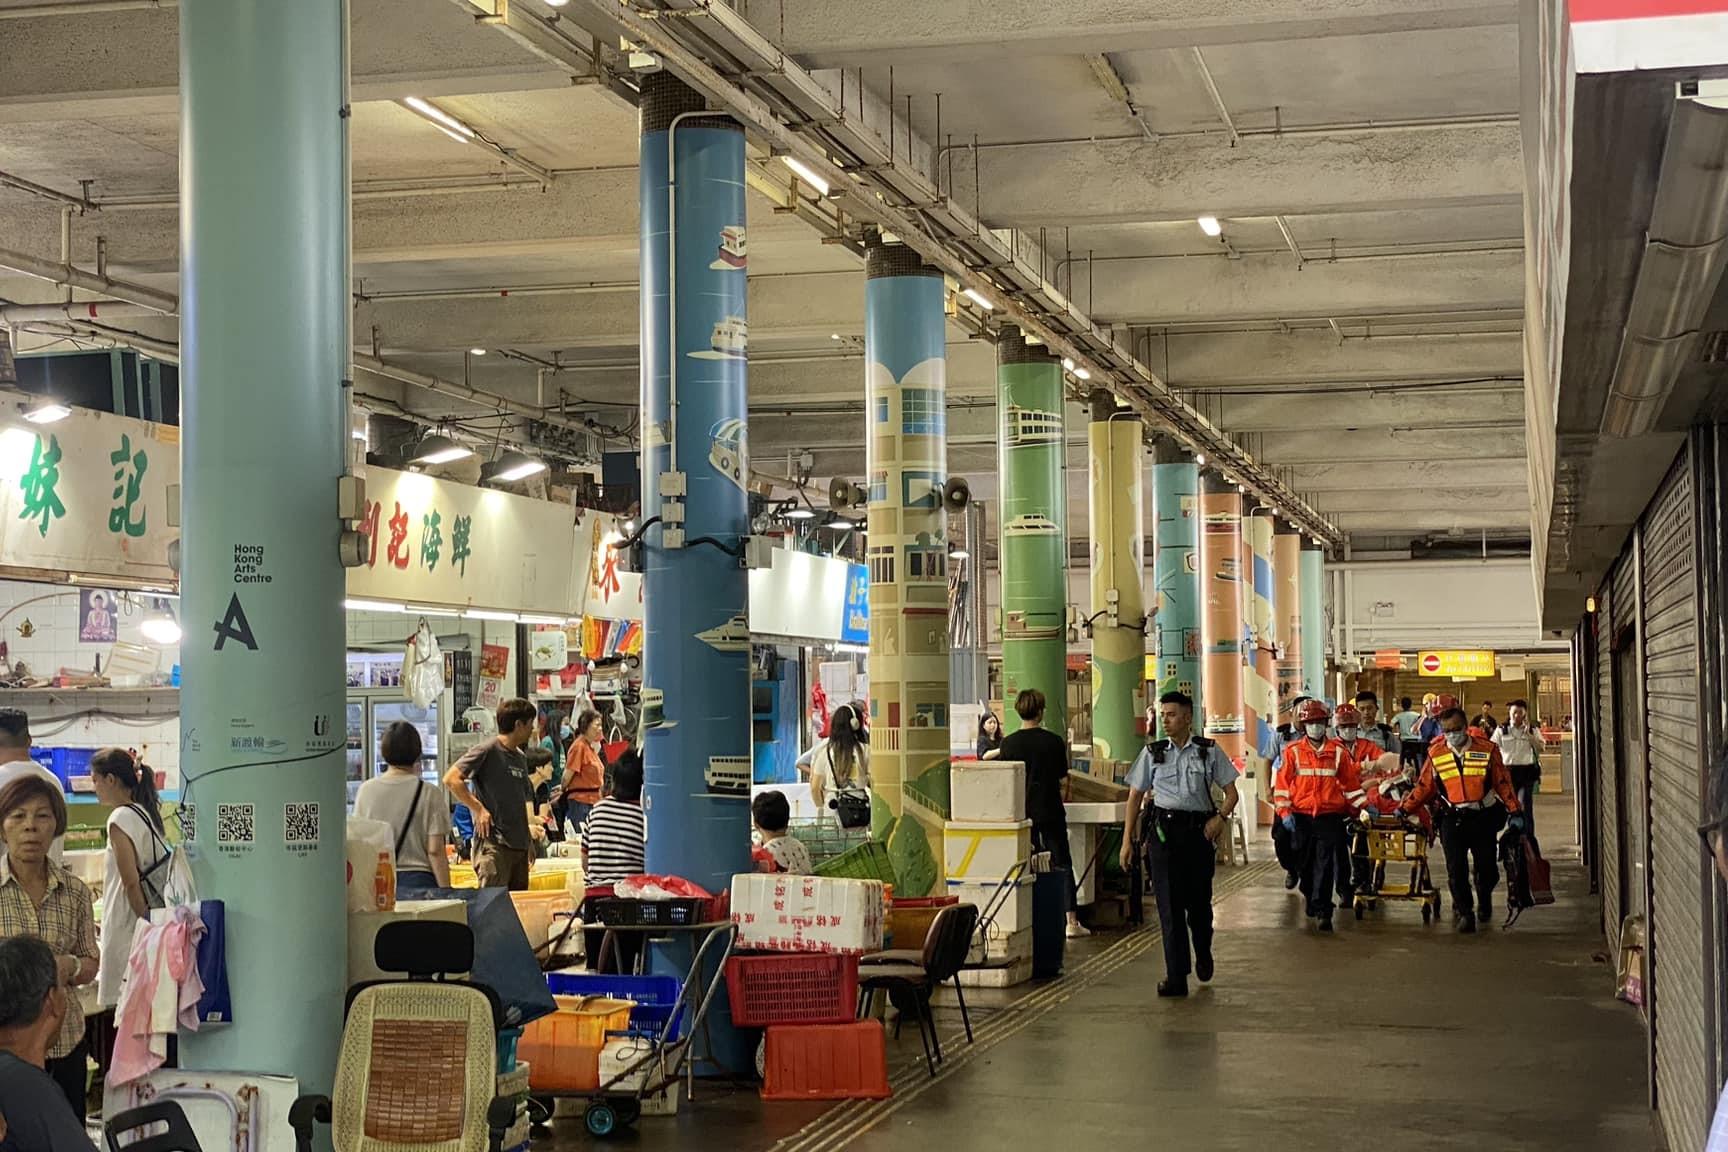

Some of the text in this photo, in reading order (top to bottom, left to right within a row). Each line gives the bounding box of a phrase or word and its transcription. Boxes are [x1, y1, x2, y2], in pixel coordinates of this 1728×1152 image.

[234, 544, 264, 555] Hong
[234, 554, 263, 566] Kong
[234, 564, 256, 573] Arts
[234, 574, 273, 583] Centre
[484, 681, 497, 693] 20
